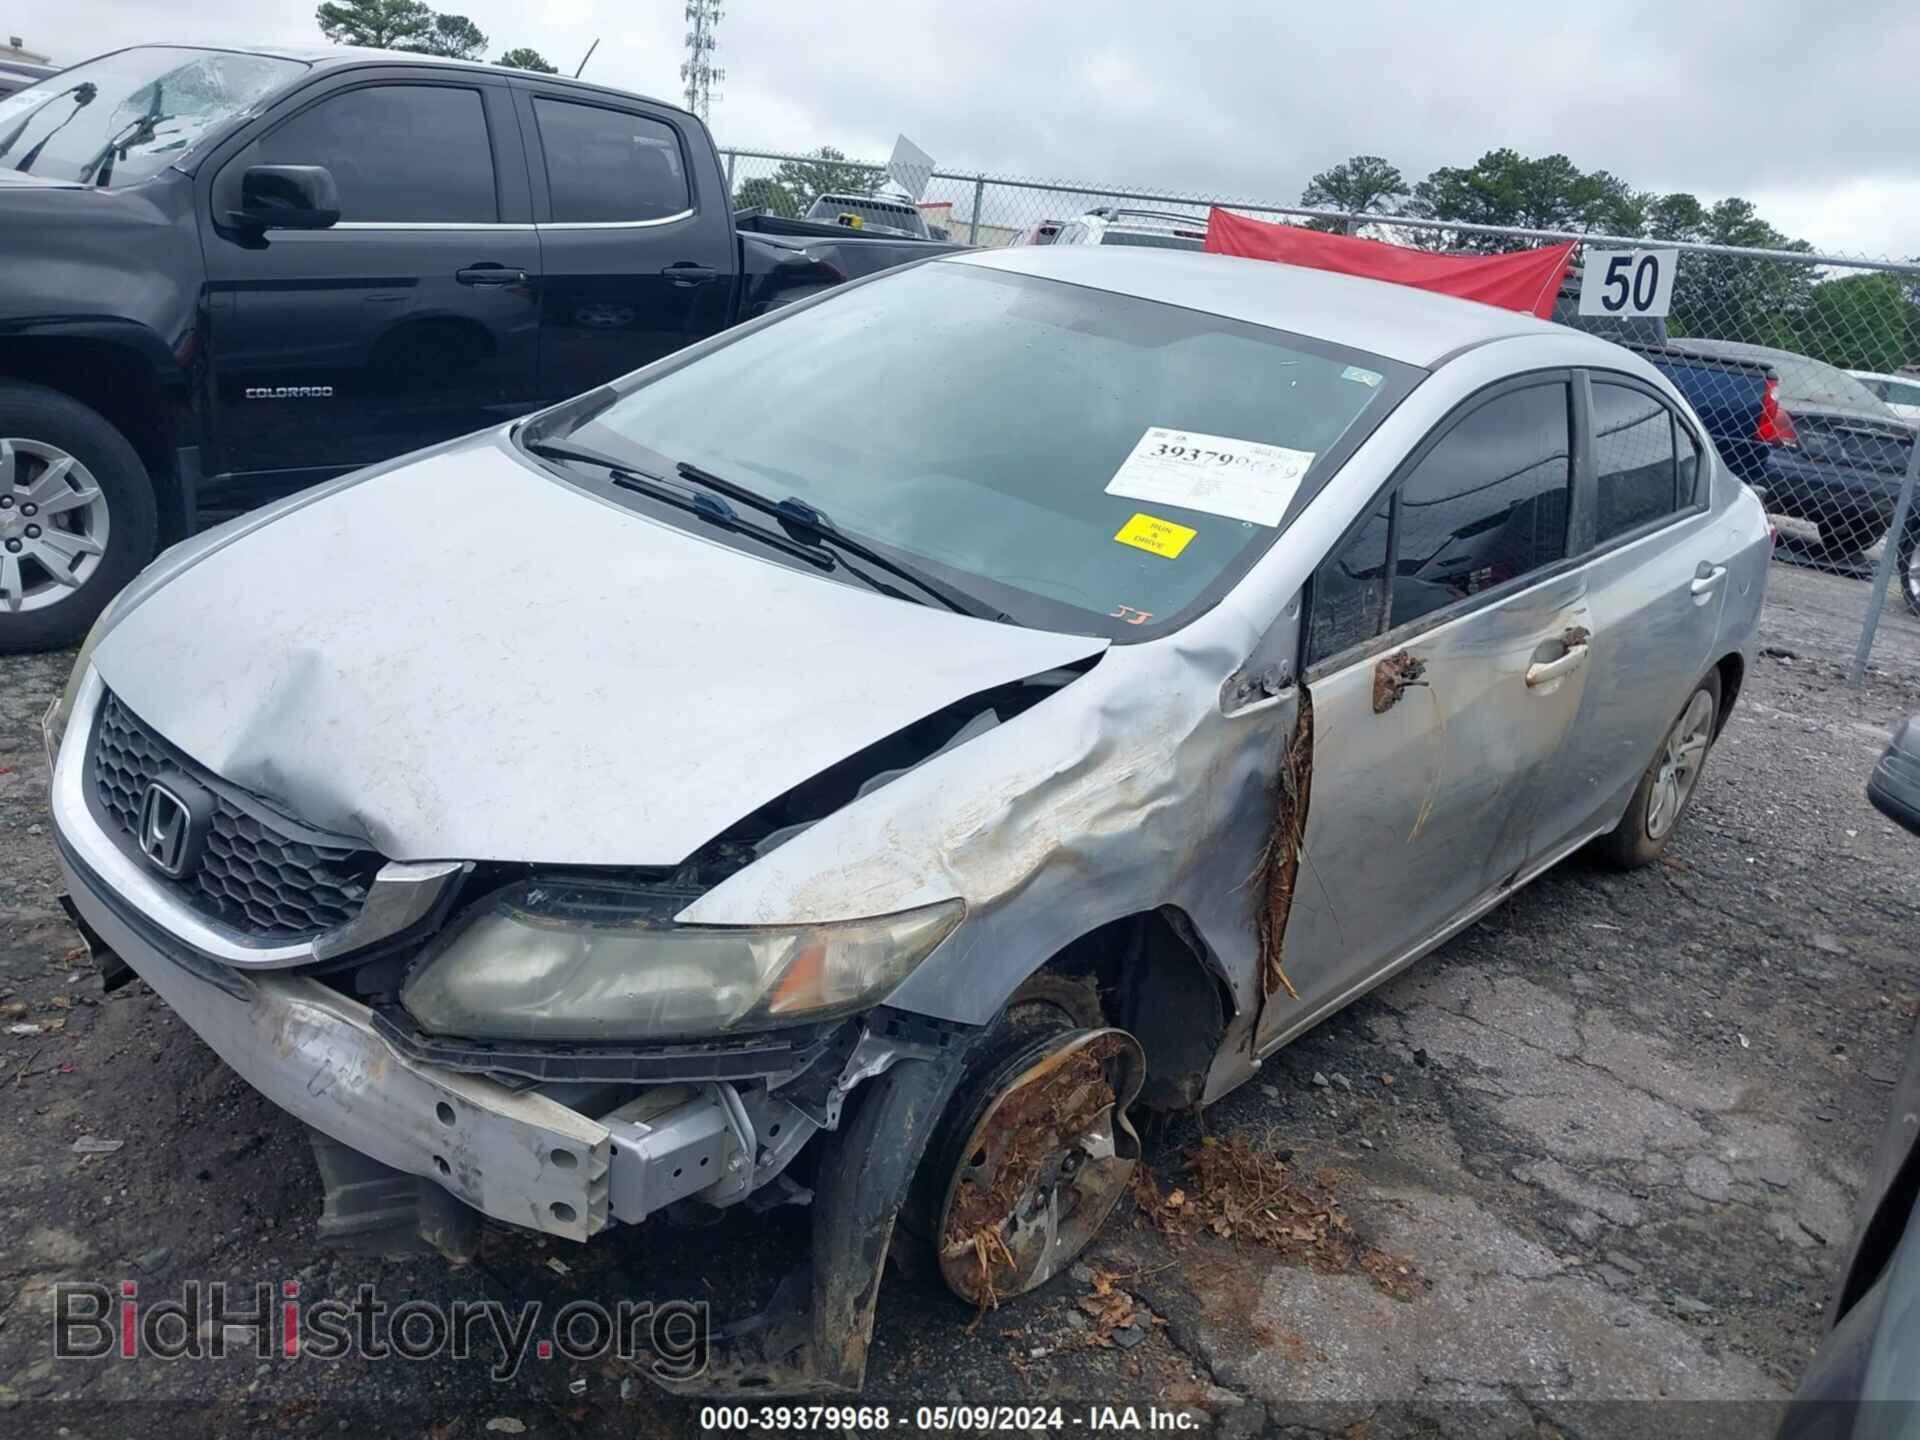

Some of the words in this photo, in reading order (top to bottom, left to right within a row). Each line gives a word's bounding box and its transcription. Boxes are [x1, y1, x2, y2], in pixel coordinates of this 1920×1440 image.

[1601, 255, 1659, 311] 50
[245, 386, 333, 399] COLORADO
[1150, 522, 1174, 534] RUN
[1134, 535, 1165, 550] DRIVE
